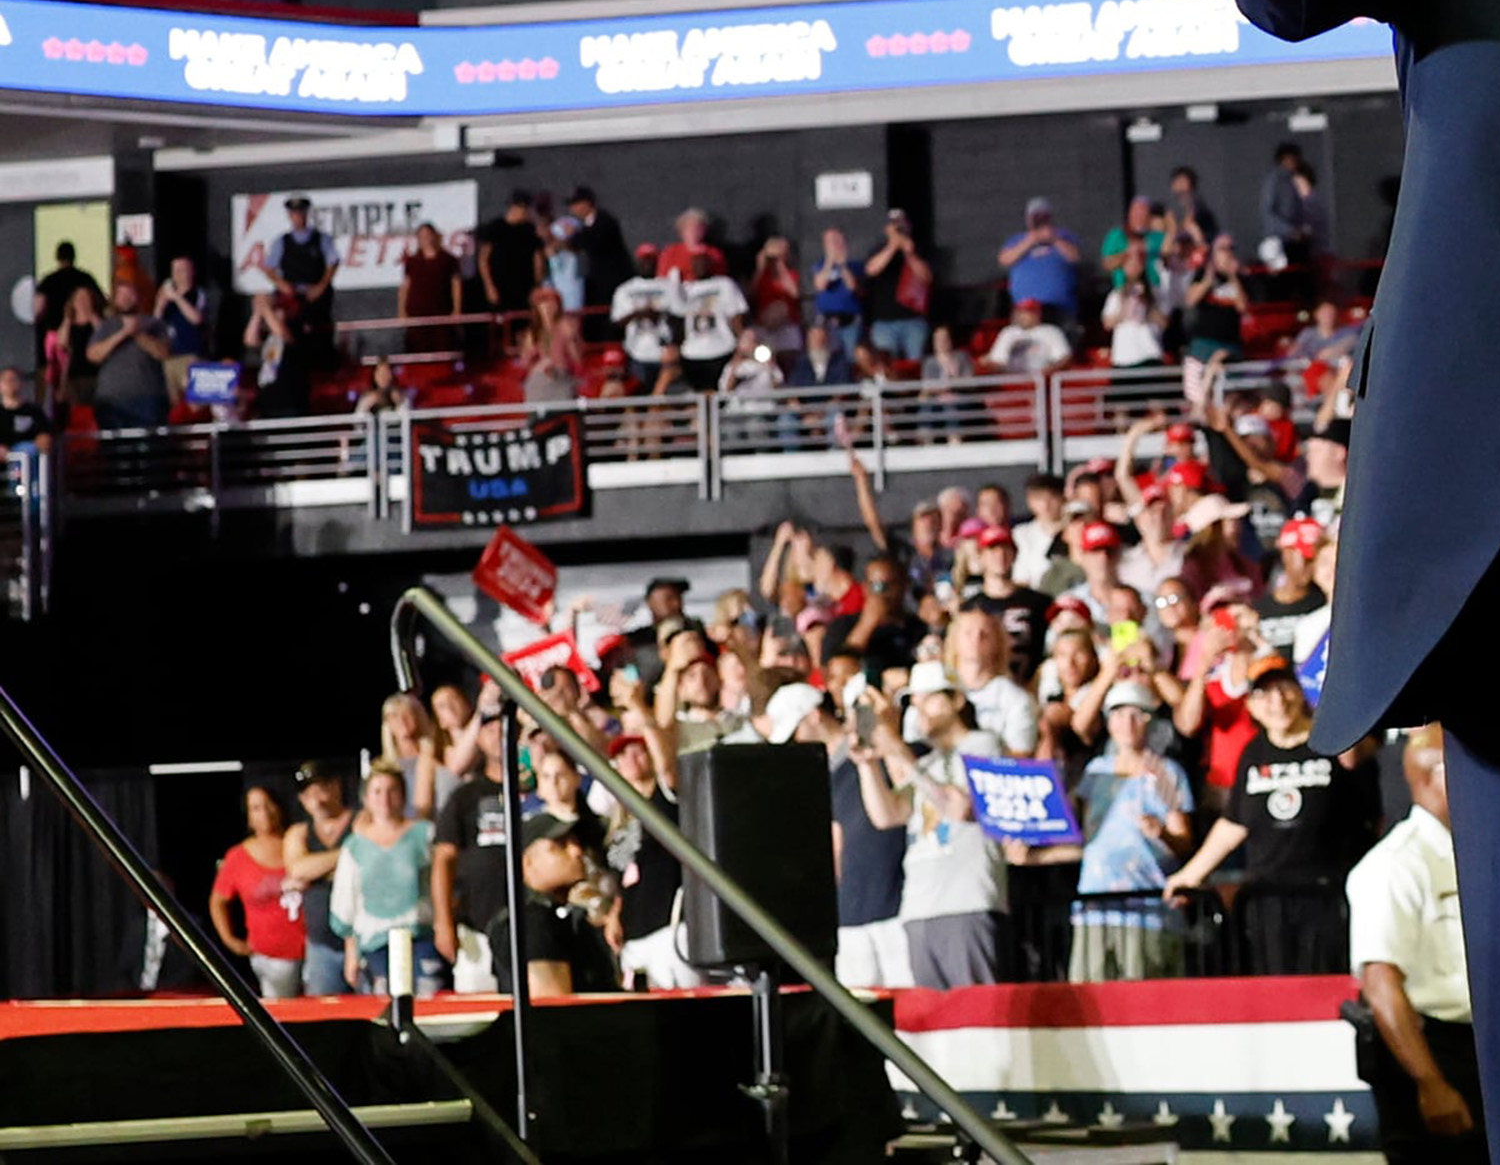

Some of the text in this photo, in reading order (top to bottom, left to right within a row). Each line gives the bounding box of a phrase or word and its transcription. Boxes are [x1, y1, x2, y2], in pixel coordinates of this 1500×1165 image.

[313, 201, 422, 238] EMPLE
[418, 433, 571, 476] TRUMP
[467, 476, 530, 501] USA
[968, 768, 1054, 798] TRUMP
[983, 792, 1049, 821] 2024
